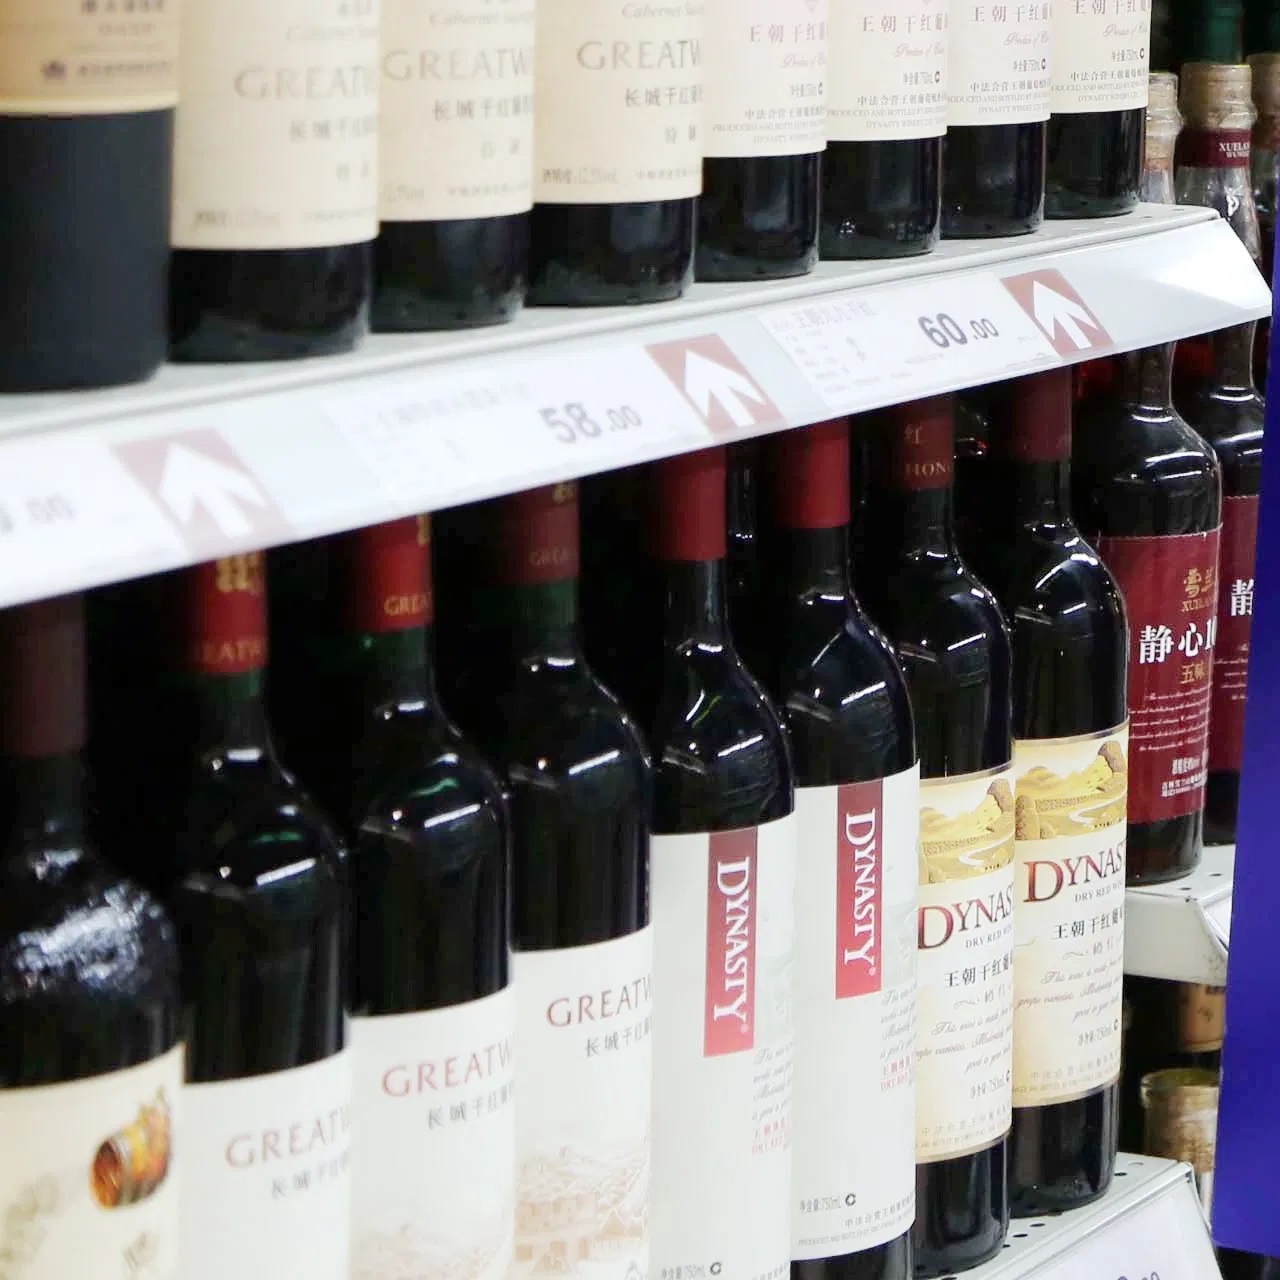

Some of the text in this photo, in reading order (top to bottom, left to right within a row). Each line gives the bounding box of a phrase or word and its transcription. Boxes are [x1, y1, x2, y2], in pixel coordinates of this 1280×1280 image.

[917, 312, 1000, 349] 60.00
[537, 401, 643, 444] 58.00
[844, 808, 876, 969] DYNASTY
[1023, 842, 1125, 903] DYNAS
[714, 856, 750, 1023] DYNASTY
